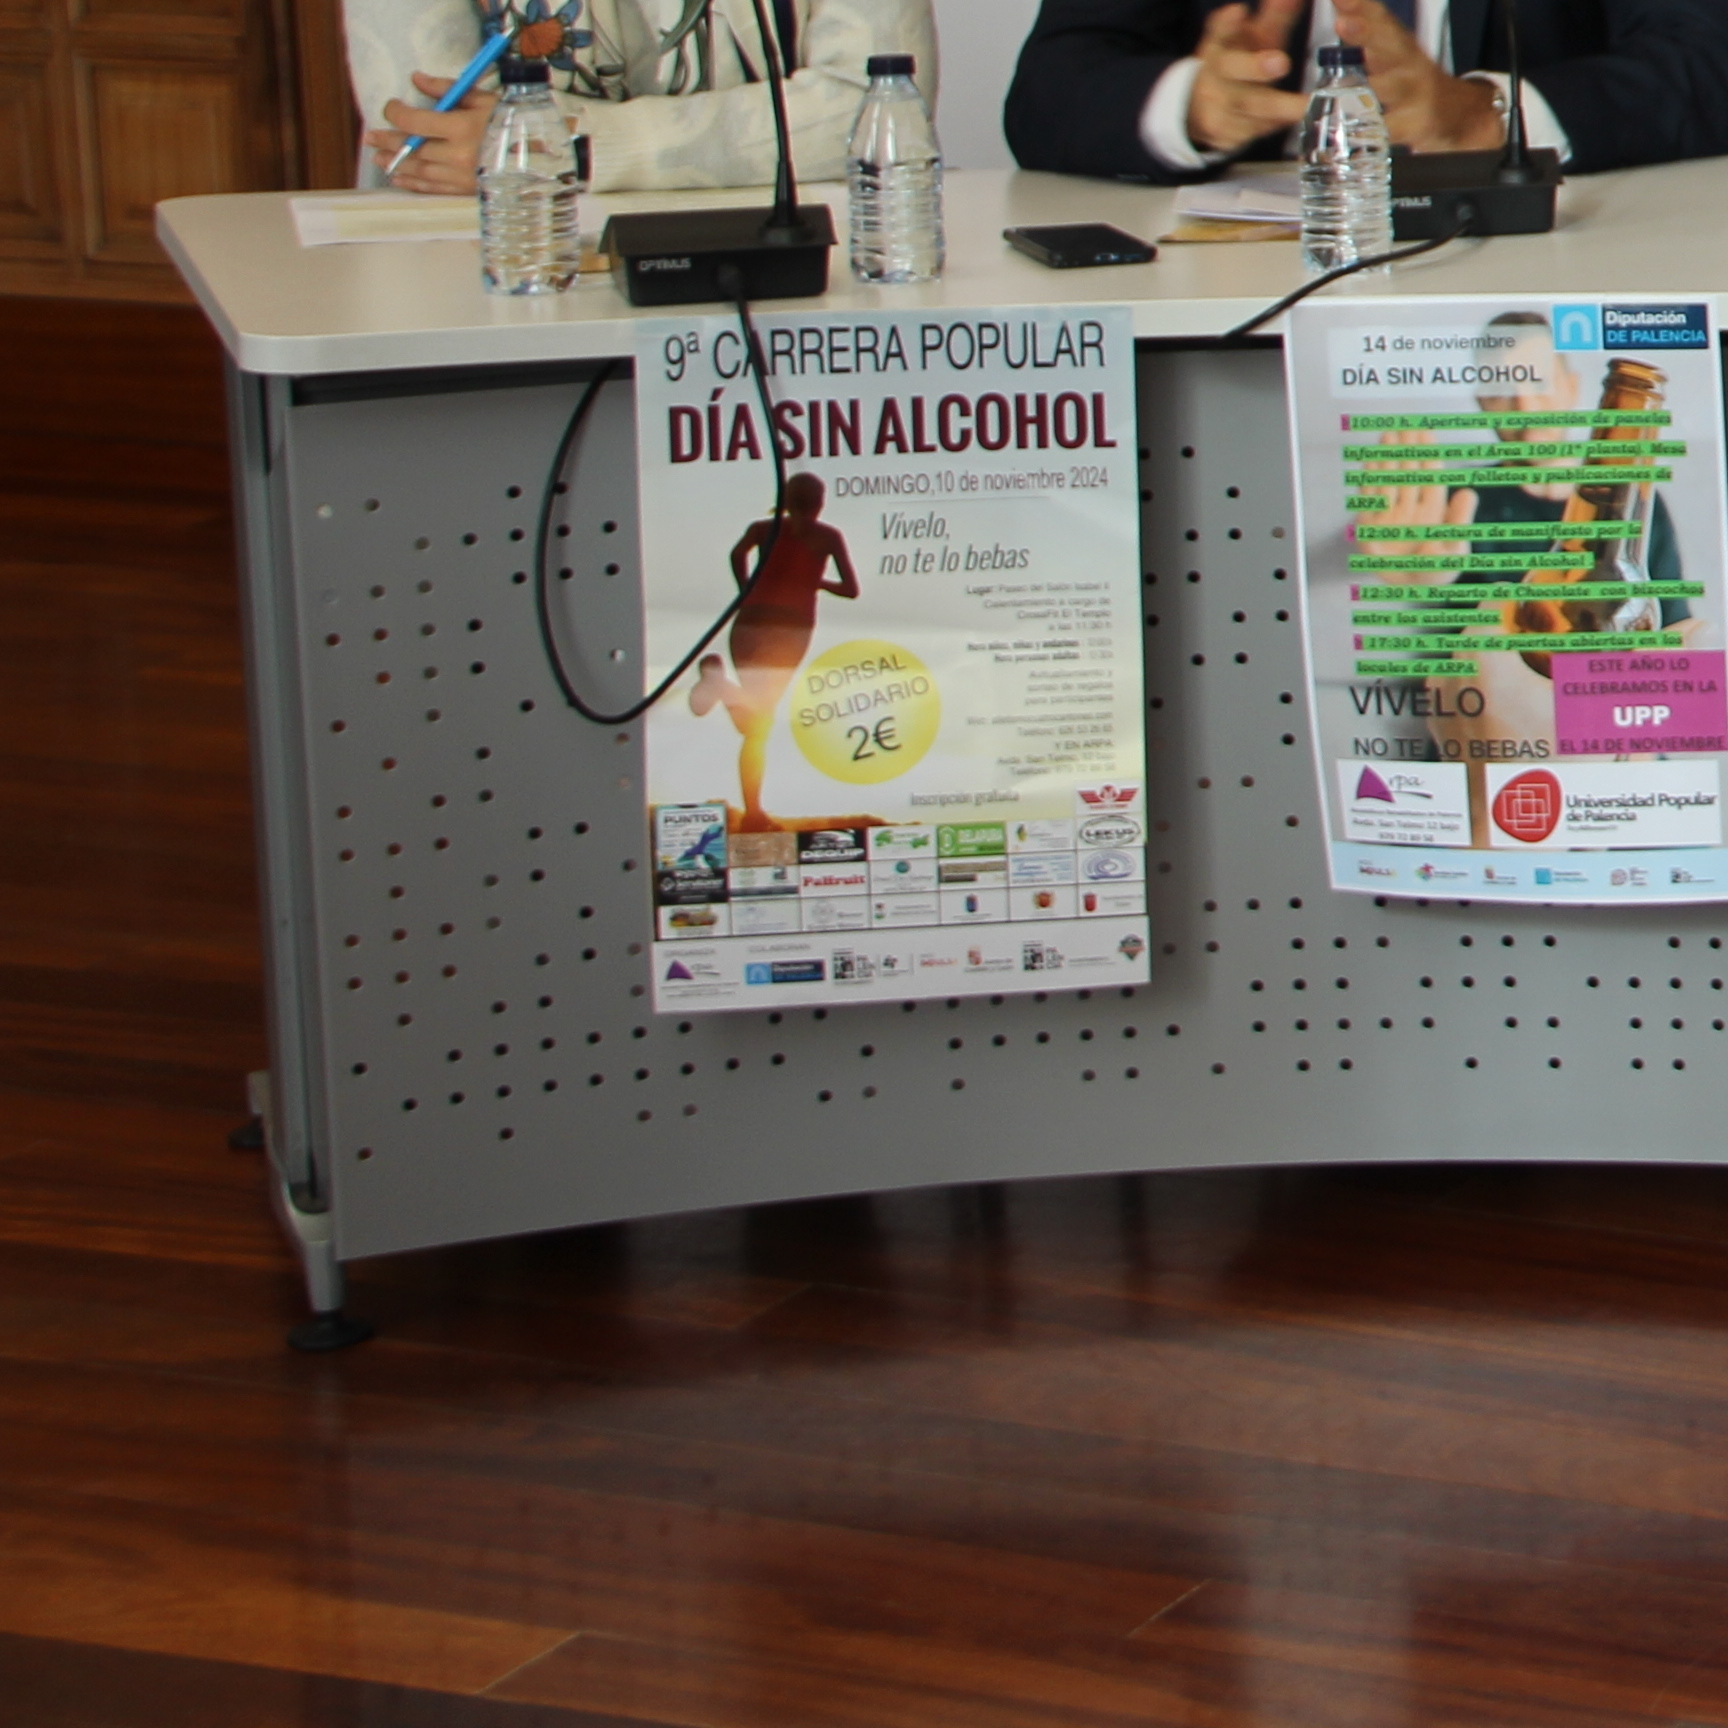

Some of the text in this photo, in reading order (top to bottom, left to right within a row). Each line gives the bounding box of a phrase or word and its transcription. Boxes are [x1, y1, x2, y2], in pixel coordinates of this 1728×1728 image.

[1605, 310, 1687, 327] Diputación
[1363, 334, 1515, 352] 14 de noviembre
[1607, 328, 1707, 343] DE PALENCIA
[665, 321, 1104, 382] 9ª CARRERA POPULAR
[1343, 363, 1542, 386] DÍA SIN ALCOHOL
[669, 388, 1117, 463] DÍA SIN ALCOHOL
[960, 470, 979, 492] de
[984, 469, 1066, 490] noviembre
[1070, 467, 1109, 489] 2024
[881, 511, 951, 541] Vívelo,
[880, 544, 1030, 575] no te lo bebas
[807, 653, 907, 696] DORSAL
[1589, 654, 1690, 672] ESTE AÑO LO
[1350, 679, 1485, 718] VÍVELO
[1563, 679, 1717, 696] CELEBRAMOS EN LA
[799, 675, 931, 727] SOLIDARIO
[1613, 705, 1671, 728] UPP
[846, 717, 903, 762] 2€
[1354, 738, 1388, 756] NO
[1396, 738, 1424, 756] TE
[1470, 739, 1550, 759] BEBAS
[1560, 736, 1725, 753] EL 14 DE NOVIEMBRE
[1566, 792, 1718, 812] Universidad Popular
[1566, 807, 1637, 822] de Palencia
